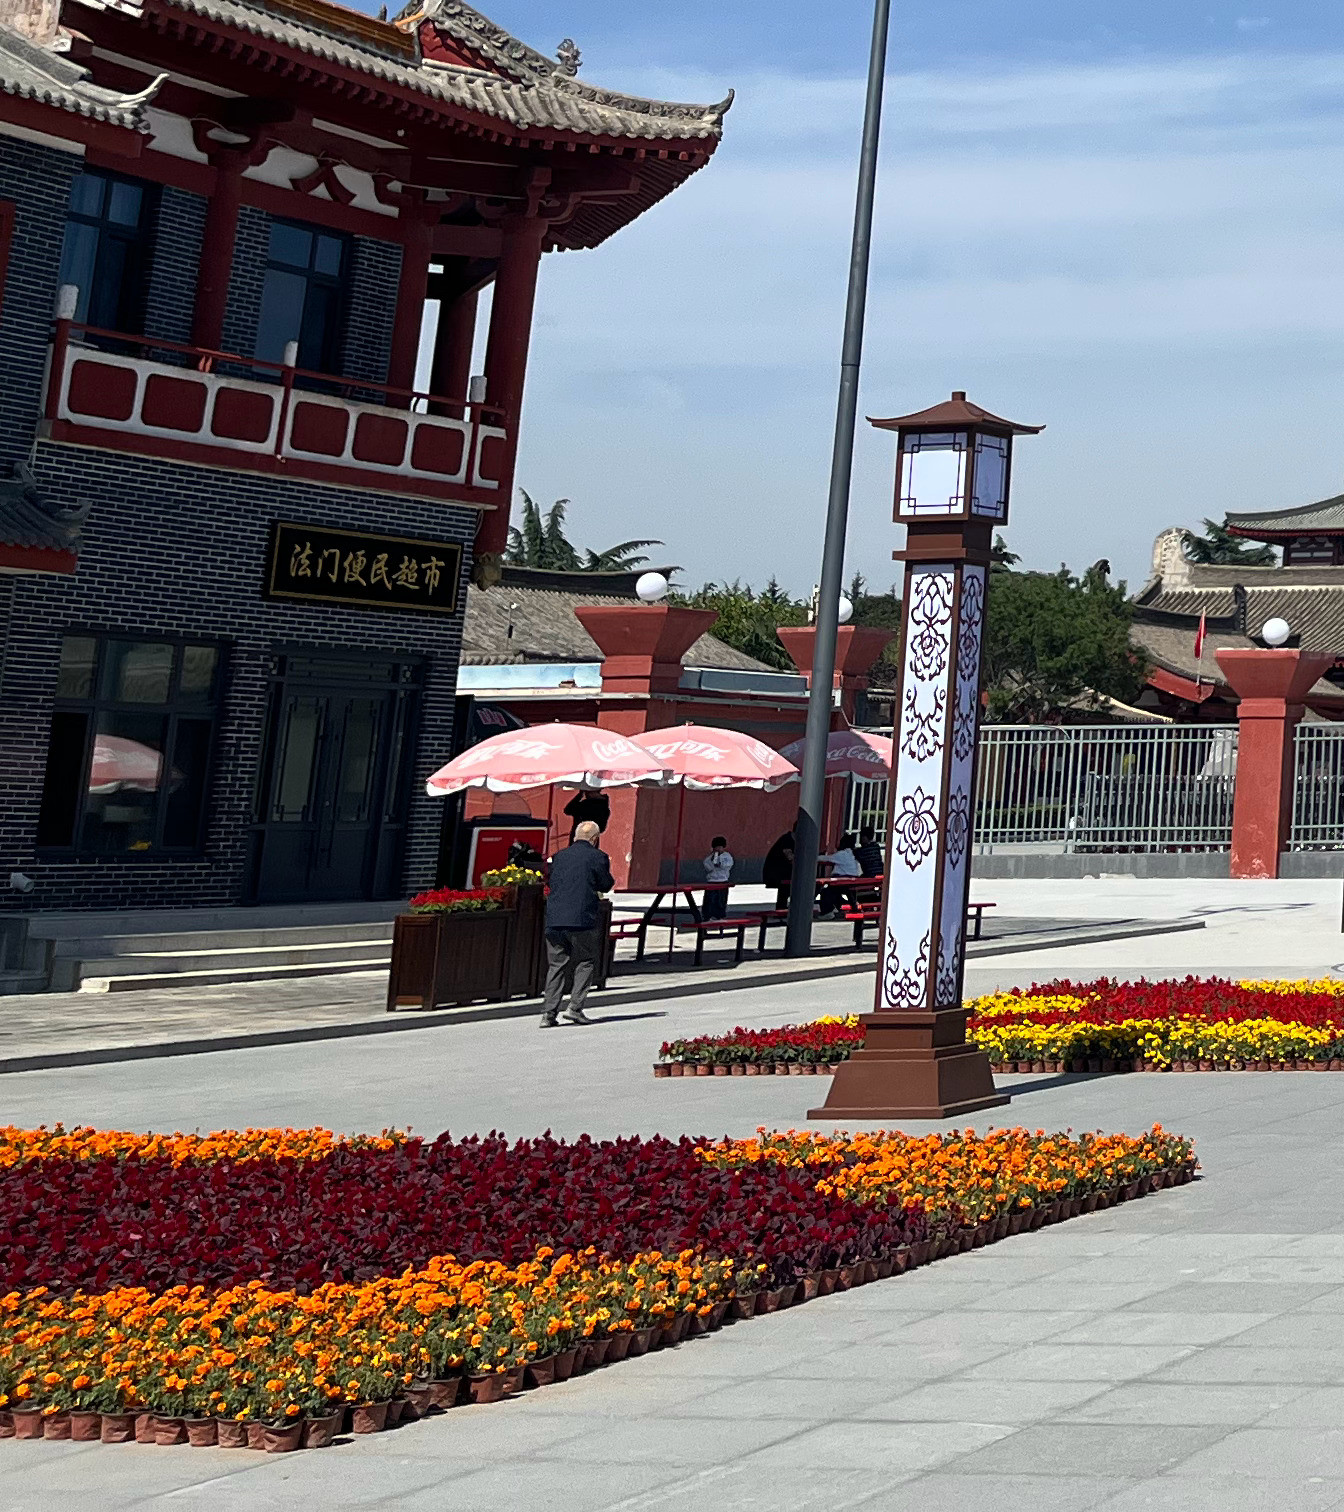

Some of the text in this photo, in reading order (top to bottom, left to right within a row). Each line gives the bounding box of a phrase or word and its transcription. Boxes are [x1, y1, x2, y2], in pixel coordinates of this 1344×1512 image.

[289, 542, 445, 595] 法门便民超市
